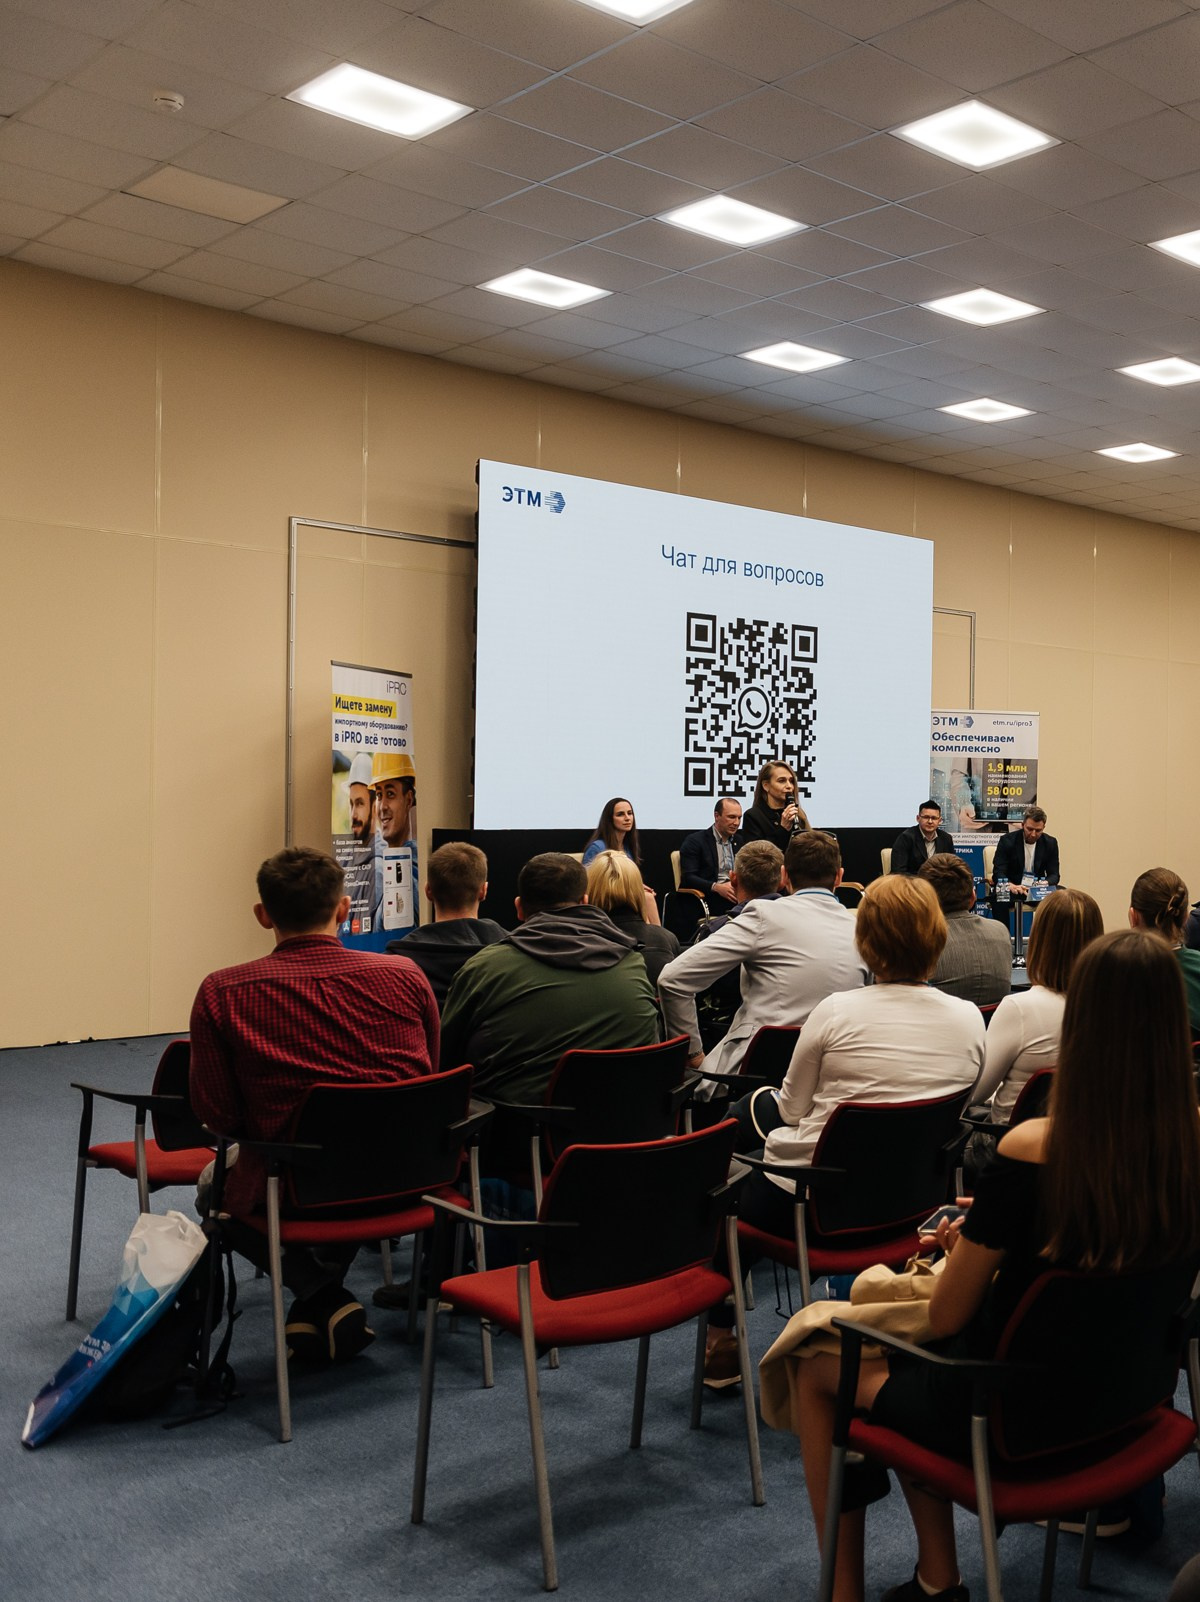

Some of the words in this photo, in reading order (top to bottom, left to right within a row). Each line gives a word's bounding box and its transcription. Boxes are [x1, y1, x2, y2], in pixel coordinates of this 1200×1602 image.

[502, 486, 541, 508] ЭТМ
[662, 544, 698, 568] Чат
[702, 556, 737, 576] для
[744, 562, 824, 587] вопросов
[335, 696, 363, 712] Ищете
[365, 702, 393, 717] замену
[335, 719, 368, 729] импортному
[370, 721, 408, 731] оборудованию?
[932, 716, 958, 726] ЭТМ
[334, 734, 340, 742] в
[342, 731, 362, 744] iPRO
[365, 734, 378, 745] всё
[381, 737, 407, 747] готово
[932, 732, 1015, 743] Обеспечиваем
[932, 744, 1001, 753] комплексно
[988, 762, 1004, 772] 1,9
[987, 786, 1000, 795] 58
[1002, 787, 1023, 795] 000
